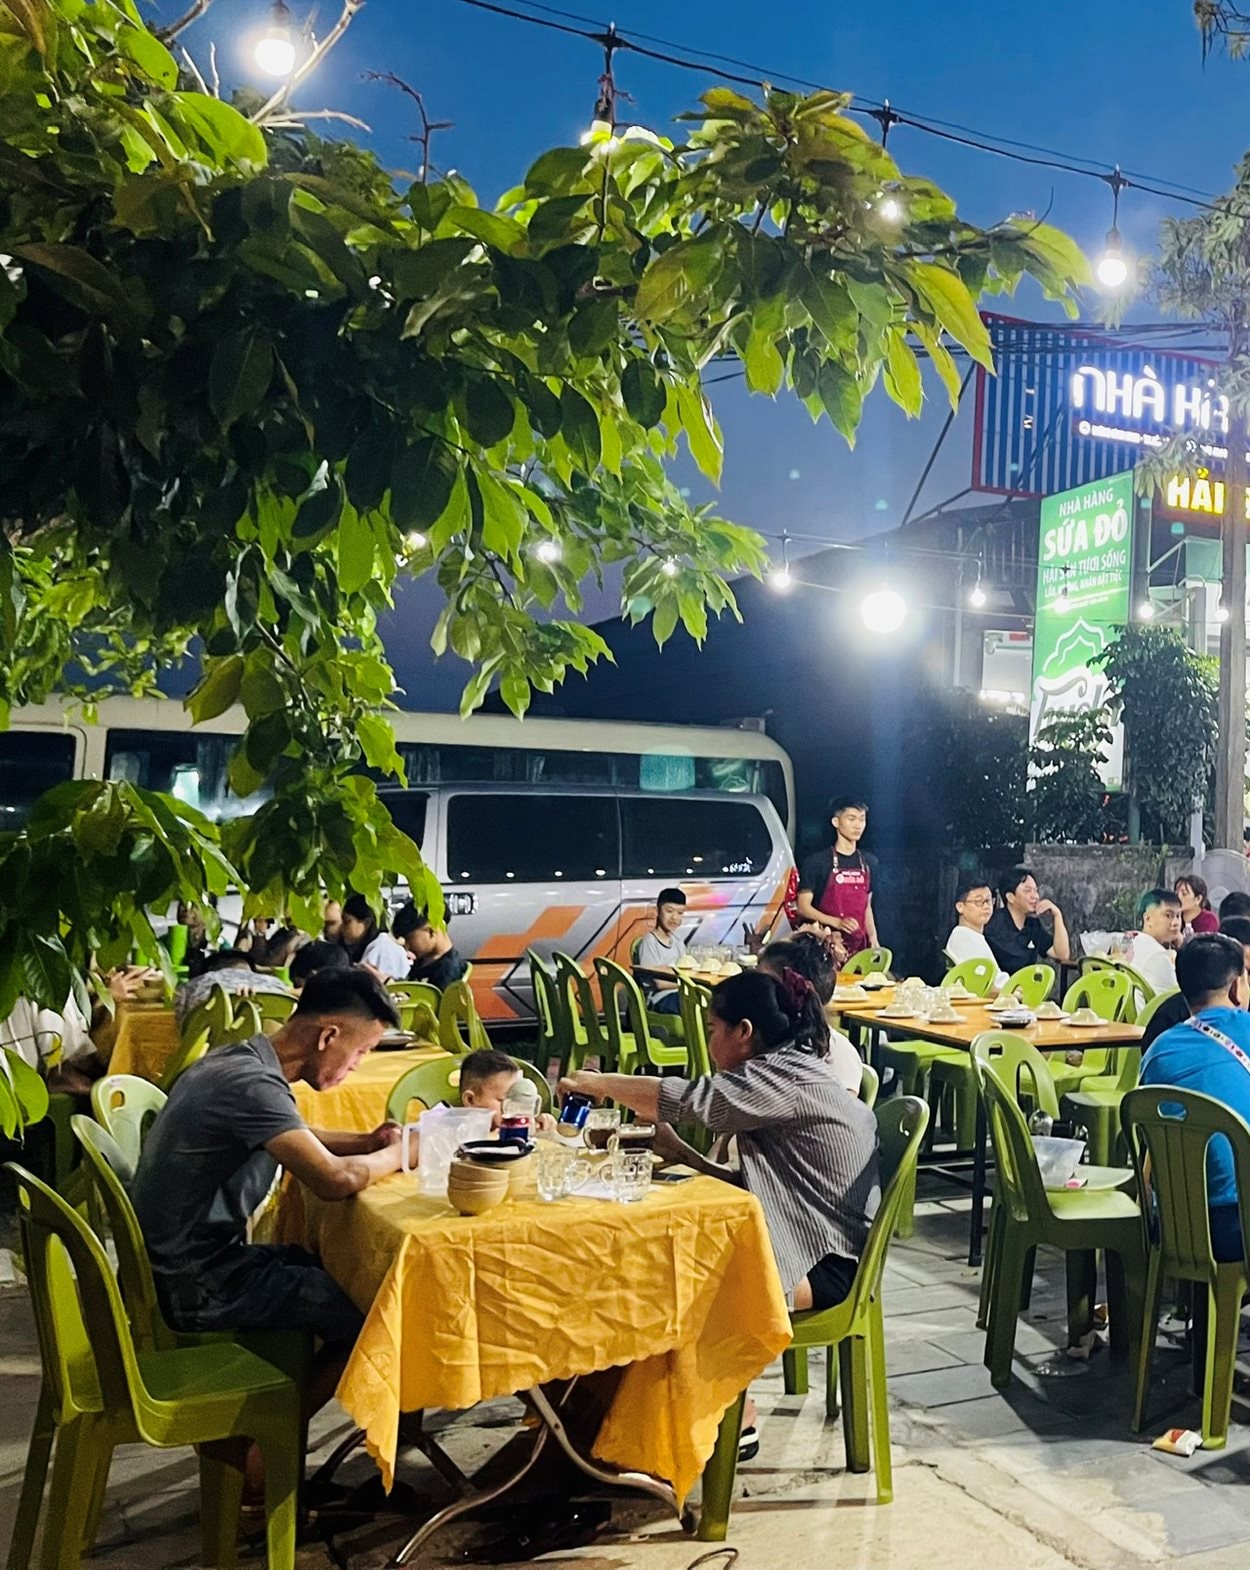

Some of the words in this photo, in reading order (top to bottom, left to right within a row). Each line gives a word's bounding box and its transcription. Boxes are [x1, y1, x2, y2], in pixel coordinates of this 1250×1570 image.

[1072, 364, 1165, 422] NHÀ
[1059, 496, 1081, 517] NHÀ
[1083, 488, 1114, 509] HÀNG
[1167, 467, 1226, 515] HẢI
[1043, 517, 1089, 561] SỨA
[1093, 498, 1129, 548] ĐỎ
[1043, 563, 1058, 585] HẢI
[1079, 556, 1100, 576] TƯƠI
[1101, 548, 1127, 571] SỐNG
